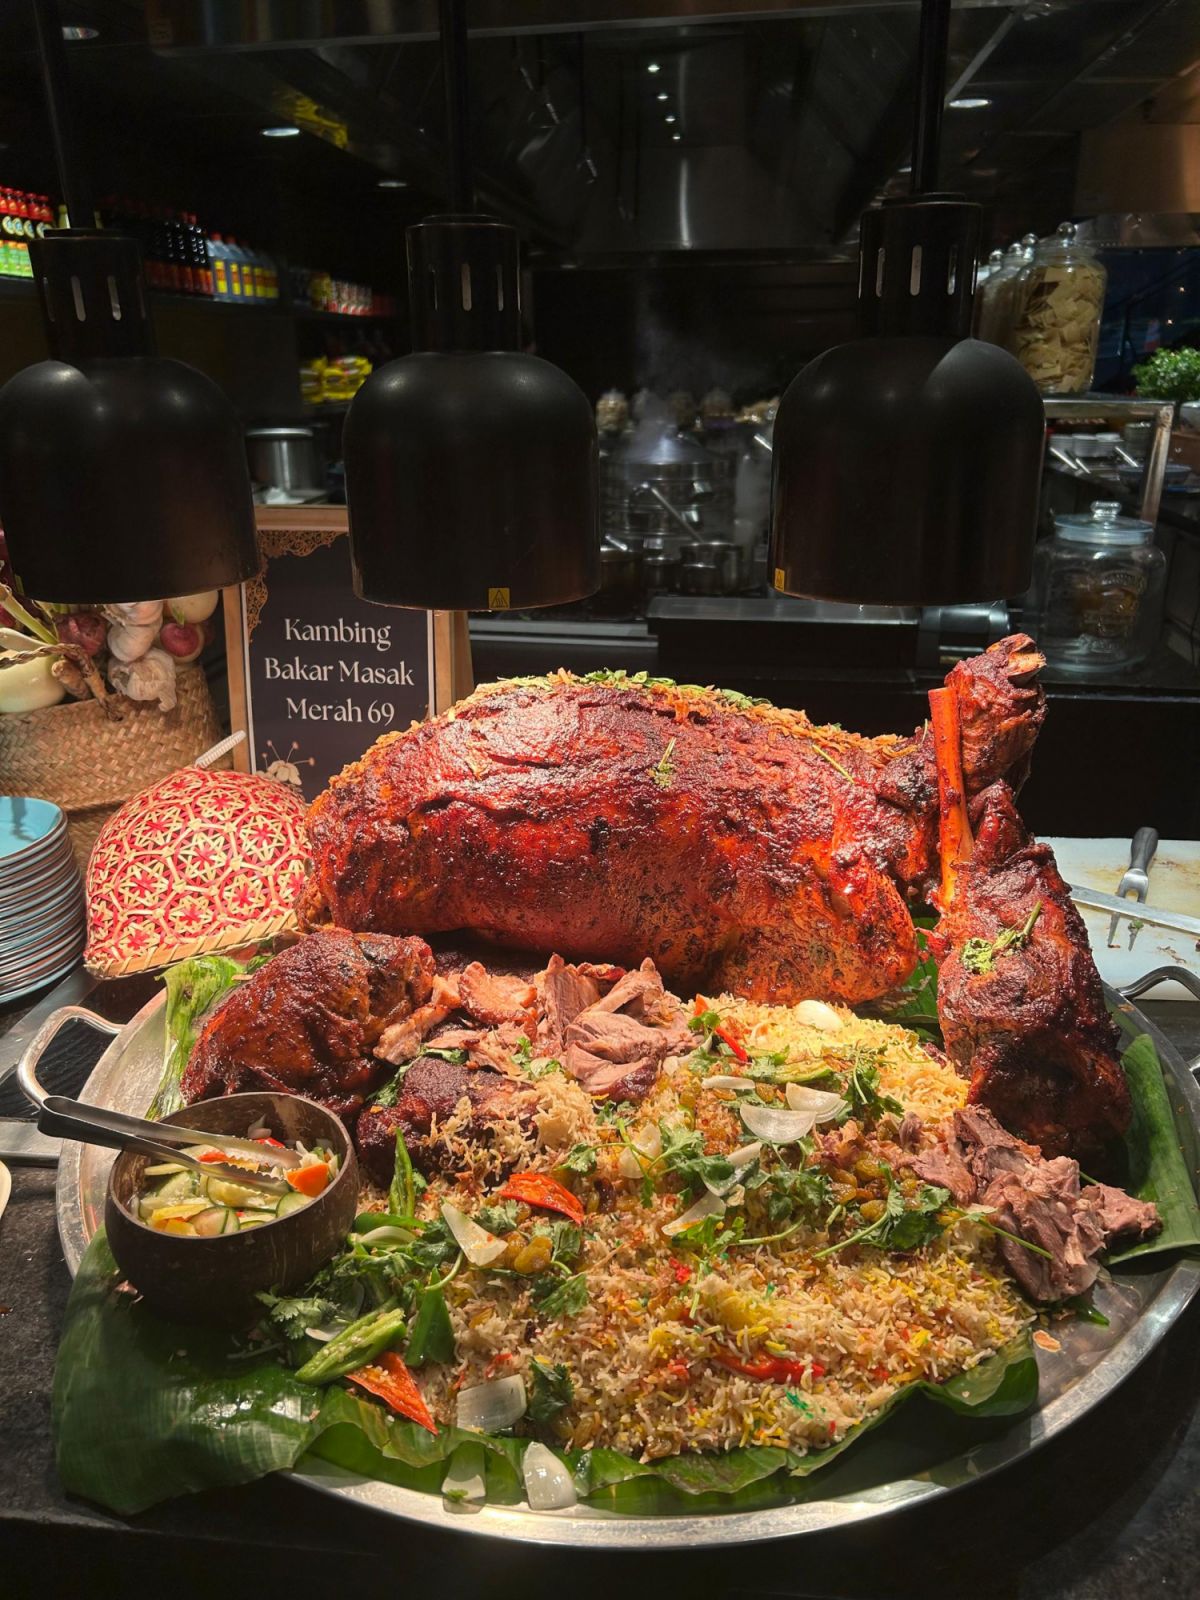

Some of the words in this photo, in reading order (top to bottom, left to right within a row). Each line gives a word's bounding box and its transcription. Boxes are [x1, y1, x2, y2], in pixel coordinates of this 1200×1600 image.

[285, 617, 391, 651] Kambing
[264, 656, 334, 682] Bakar
[339, 660, 415, 686] Masak
[286, 697, 362, 723] Merah
[367, 700, 395, 726] 69
